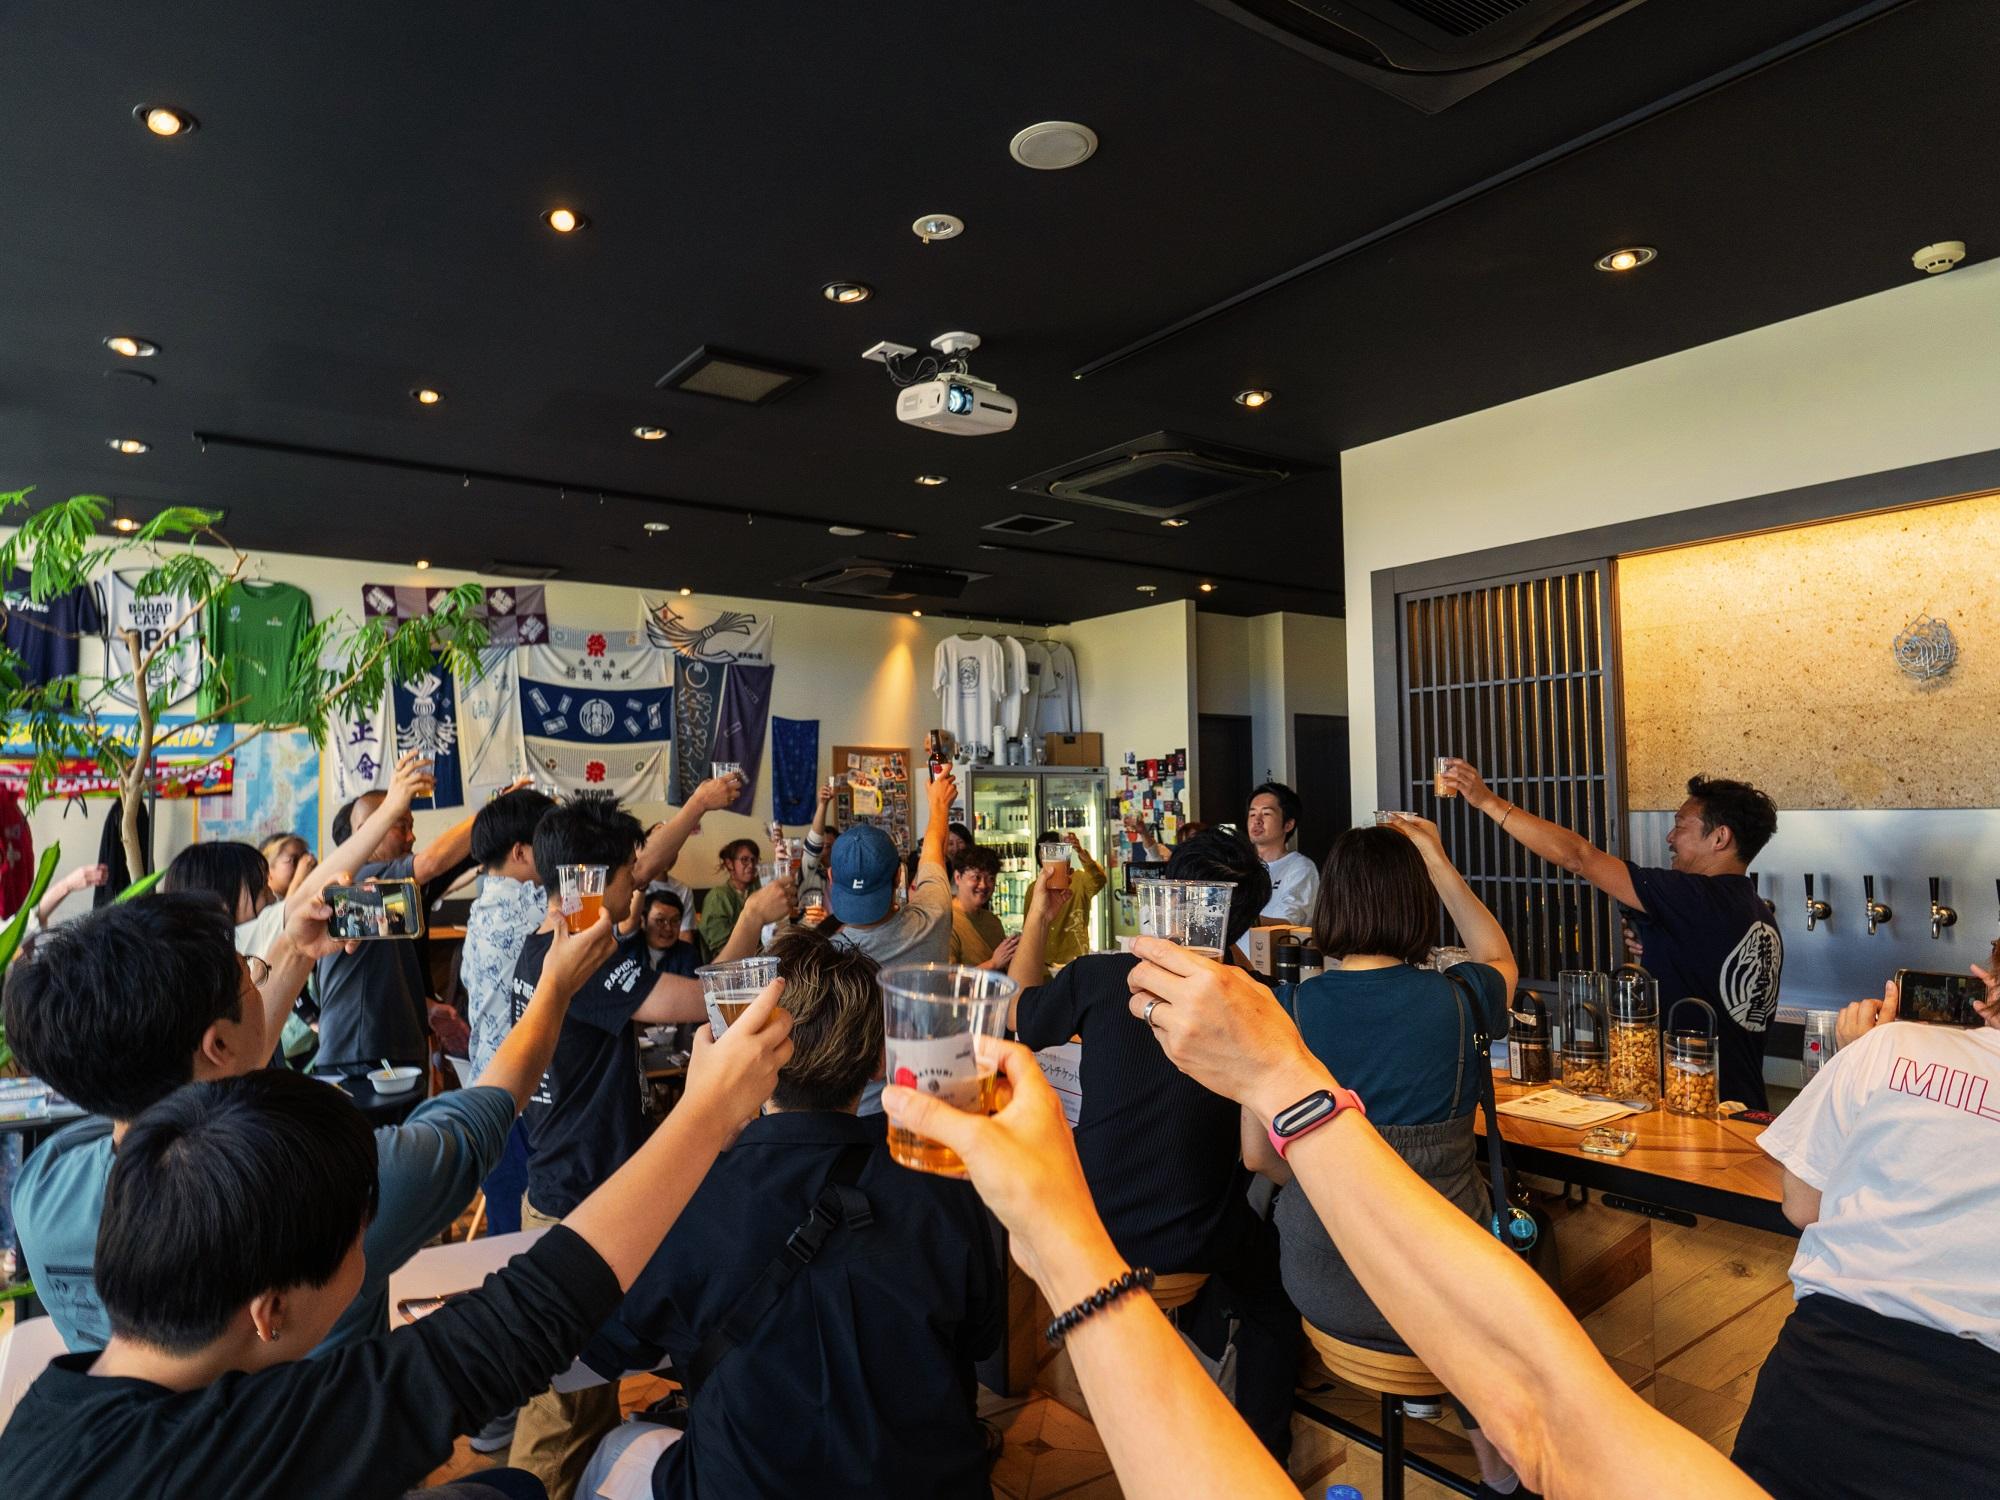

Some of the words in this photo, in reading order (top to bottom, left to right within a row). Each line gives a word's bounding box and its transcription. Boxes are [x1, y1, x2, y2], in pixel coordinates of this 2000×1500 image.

[129, 603, 172, 615] BROAD
[134, 615, 167, 625] CAST
[586, 633, 607, 658] 祭
[566, 666, 632, 681] 稲荷神社
